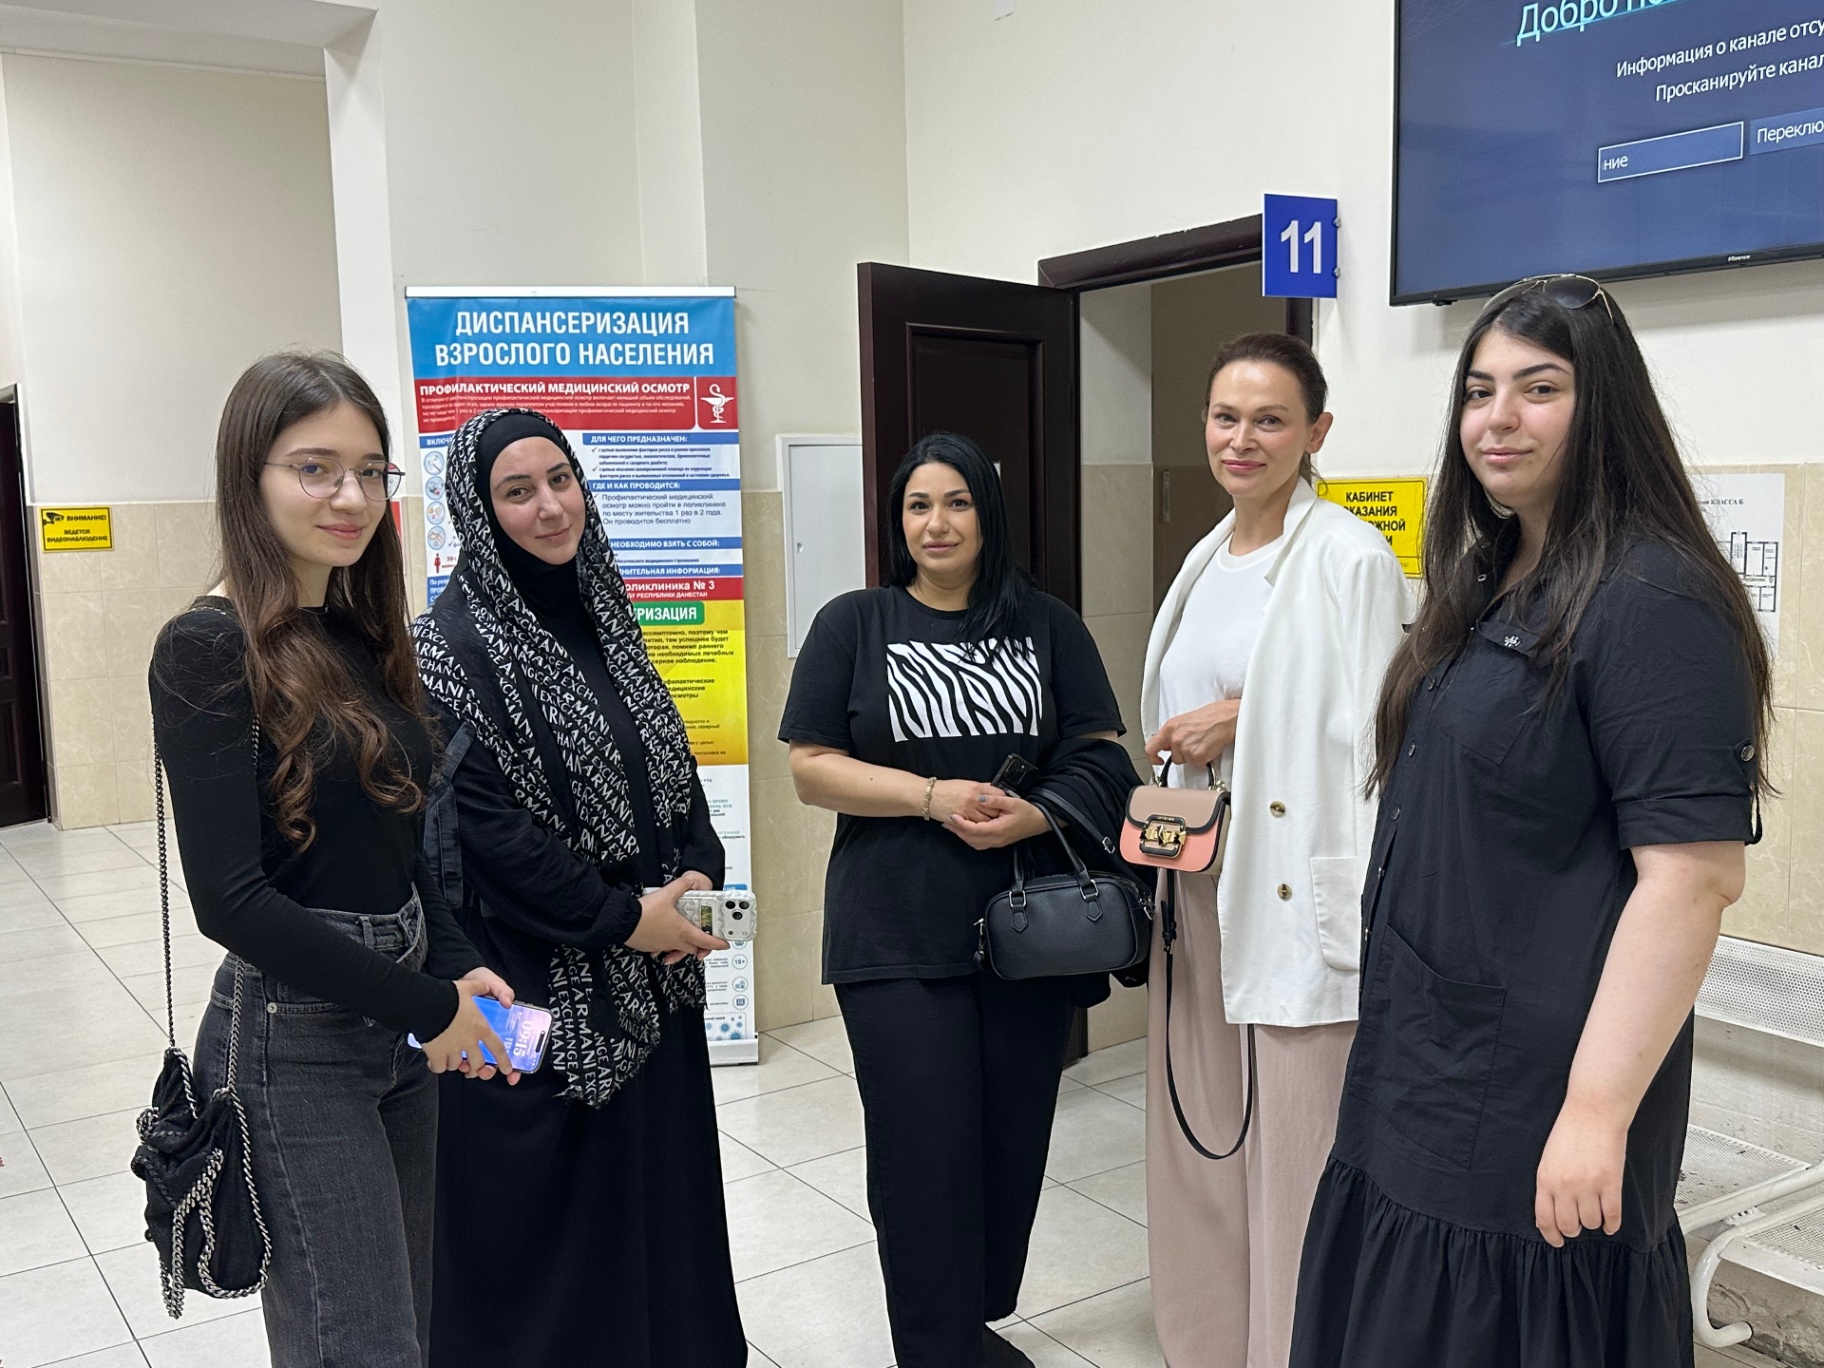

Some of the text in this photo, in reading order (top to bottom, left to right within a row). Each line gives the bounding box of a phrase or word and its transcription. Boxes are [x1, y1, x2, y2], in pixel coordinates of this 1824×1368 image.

[1517, 0, 1618, 47] Добро
[1616, 43, 1713, 78] Информация
[1716, 42, 1726, 55] о
[1729, 27, 1786, 53] канале
[1655, 64, 1776, 103] Просканируйте
[1280, 219, 1322, 274] 11
[456, 311, 689, 337] ДИСПАНСЕРИЗАЦИЯ
[435, 341, 714, 366] ВЗРОСЛОГО НАСЕЛЕНИЯ
[420, 381, 691, 396] ПРОФИЛАКТИЧЕСКИЙ МЕДИЦИНСКИЙ ОСМОТР
[591, 434, 688, 444] ДЛЯ ЧЕГО ПРЕДНАЗНАЧЕН:
[593, 483, 606, 491] ГДЕ
[614, 482, 629, 490] КАК
[629, 482, 681, 490] ПРОВОДИТСЯ:
[602, 493, 714, 502] Профилактический медицинский
[1346, 491, 1394, 502] КАБИНЕТ
[653, 501, 676, 509] пройти
[603, 516, 691, 526] Он проводится бесплатно
[613, 510, 633, 519] месту
[634, 509, 673, 517] жительства
[681, 510, 693, 518] раз
[610, 540, 662, 549] НЕОБХОДИМО
[663, 540, 686, 548] ВЗЯТЬ
[692, 539, 720, 547] СОБОЙ:
[666, 567, 721, 576] ИНФОРМАЦИЯ:
[693, 580, 706, 590] №
[708, 580, 716, 590] 3
[637, 591, 675, 599] РЕСПУБЛИКИ
[603, 643, 655, 702] ARMANI
[549, 684, 611, 736] ARMANI
[582, 764, 632, 822] ARMANI
[557, 990, 580, 1070] EXCHANGE
[572, 986, 597, 1070] ARMANI
